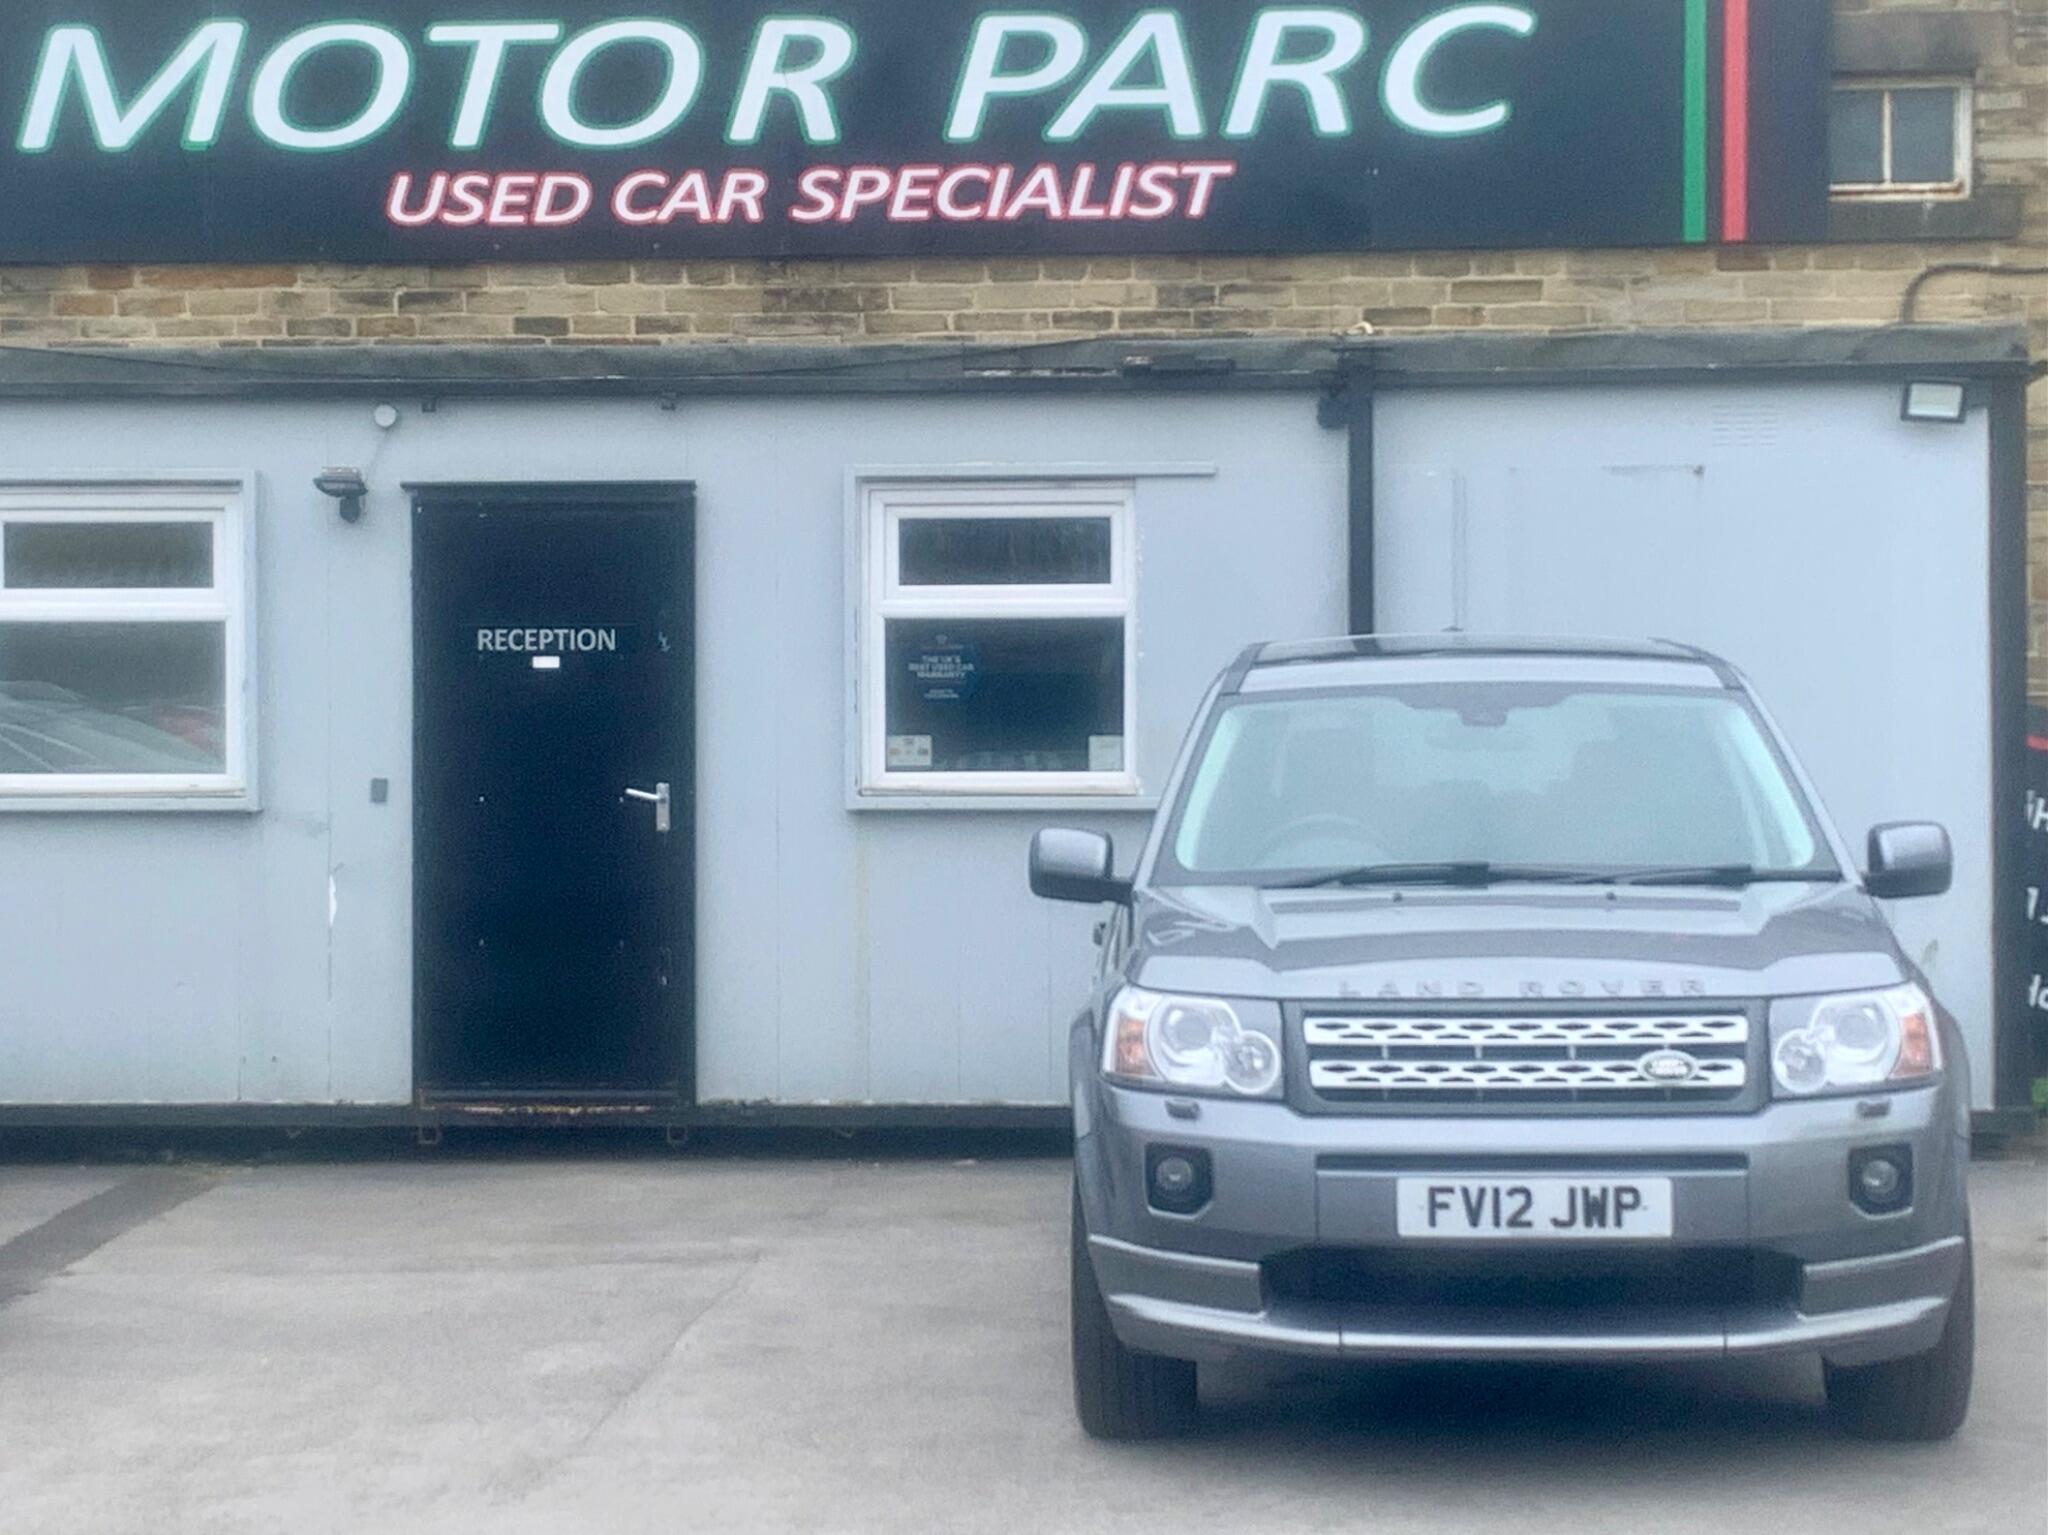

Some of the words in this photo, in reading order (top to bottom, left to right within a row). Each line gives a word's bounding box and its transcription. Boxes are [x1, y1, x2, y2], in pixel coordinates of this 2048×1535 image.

[17, 18, 857, 152] MOTOR
[944, 4, 1535, 142] PARC
[385, 172, 592, 226] USED
[611, 168, 768, 224] CAR
[790, 161, 1236, 222] SPECIALIST
[477, 629, 616, 651] RECEPTION
[1338, 980, 1485, 997] LAND
[1520, 980, 1706, 996] ROVER
[1427, 1186, 1534, 1229] FV12
[1550, 1186, 1641, 1229] JWP
